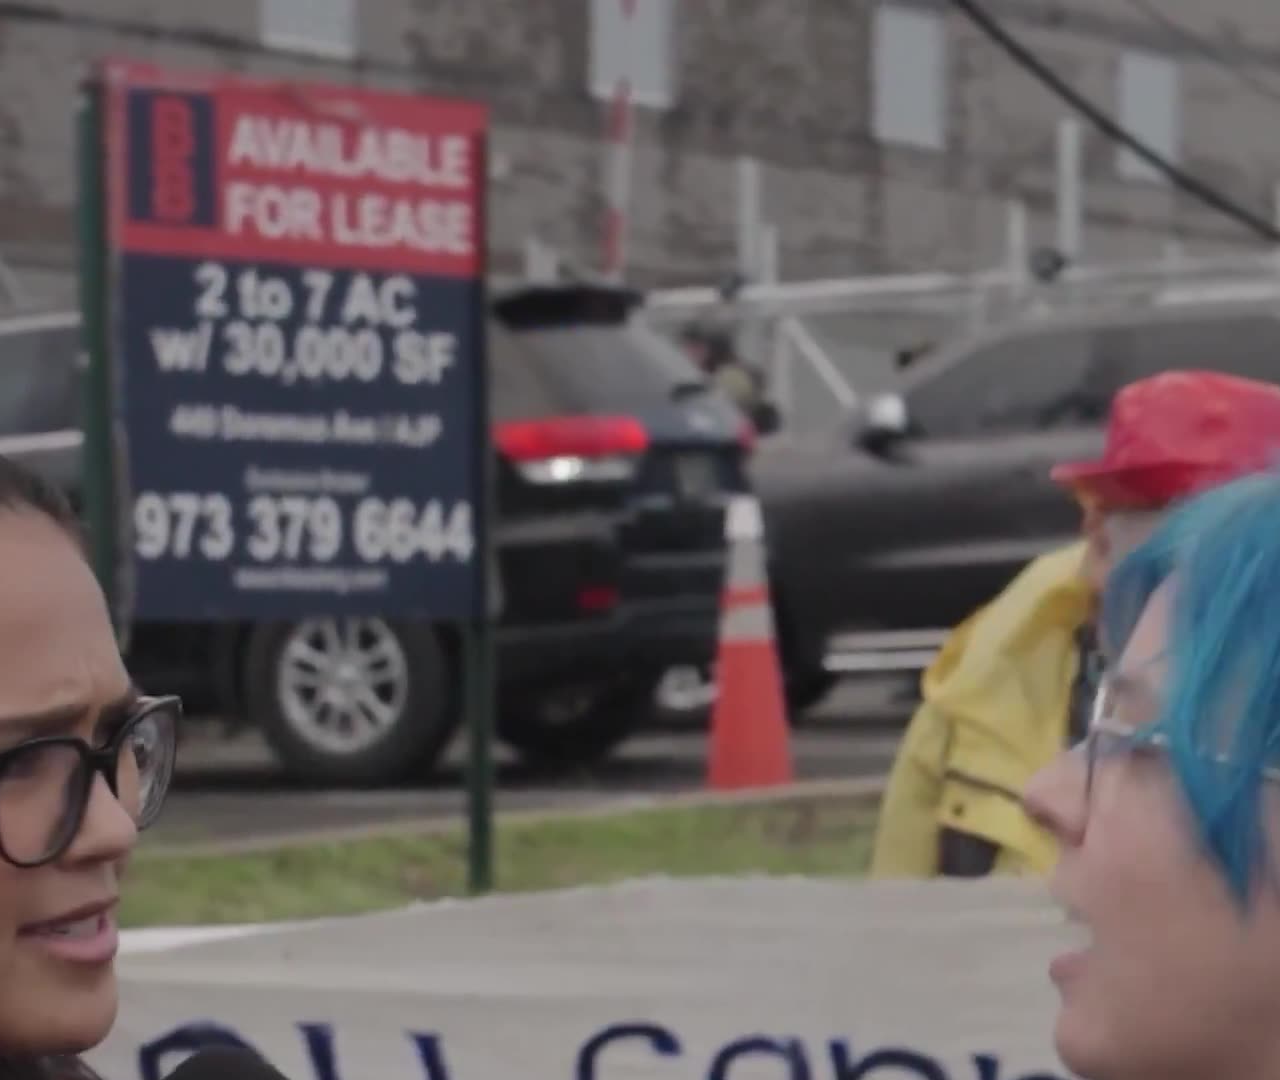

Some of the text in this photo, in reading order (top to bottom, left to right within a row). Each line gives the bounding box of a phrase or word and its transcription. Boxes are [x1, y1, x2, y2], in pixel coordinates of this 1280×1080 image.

[227, 113, 472, 187] AVAILABLE
[224, 184, 474, 254] FOR LEASE
[194, 263, 418, 328] 2 to 7 AC
[150, 324, 457, 386] w/ 30,000 SF
[133, 492, 474, 564] 973 379 6644
